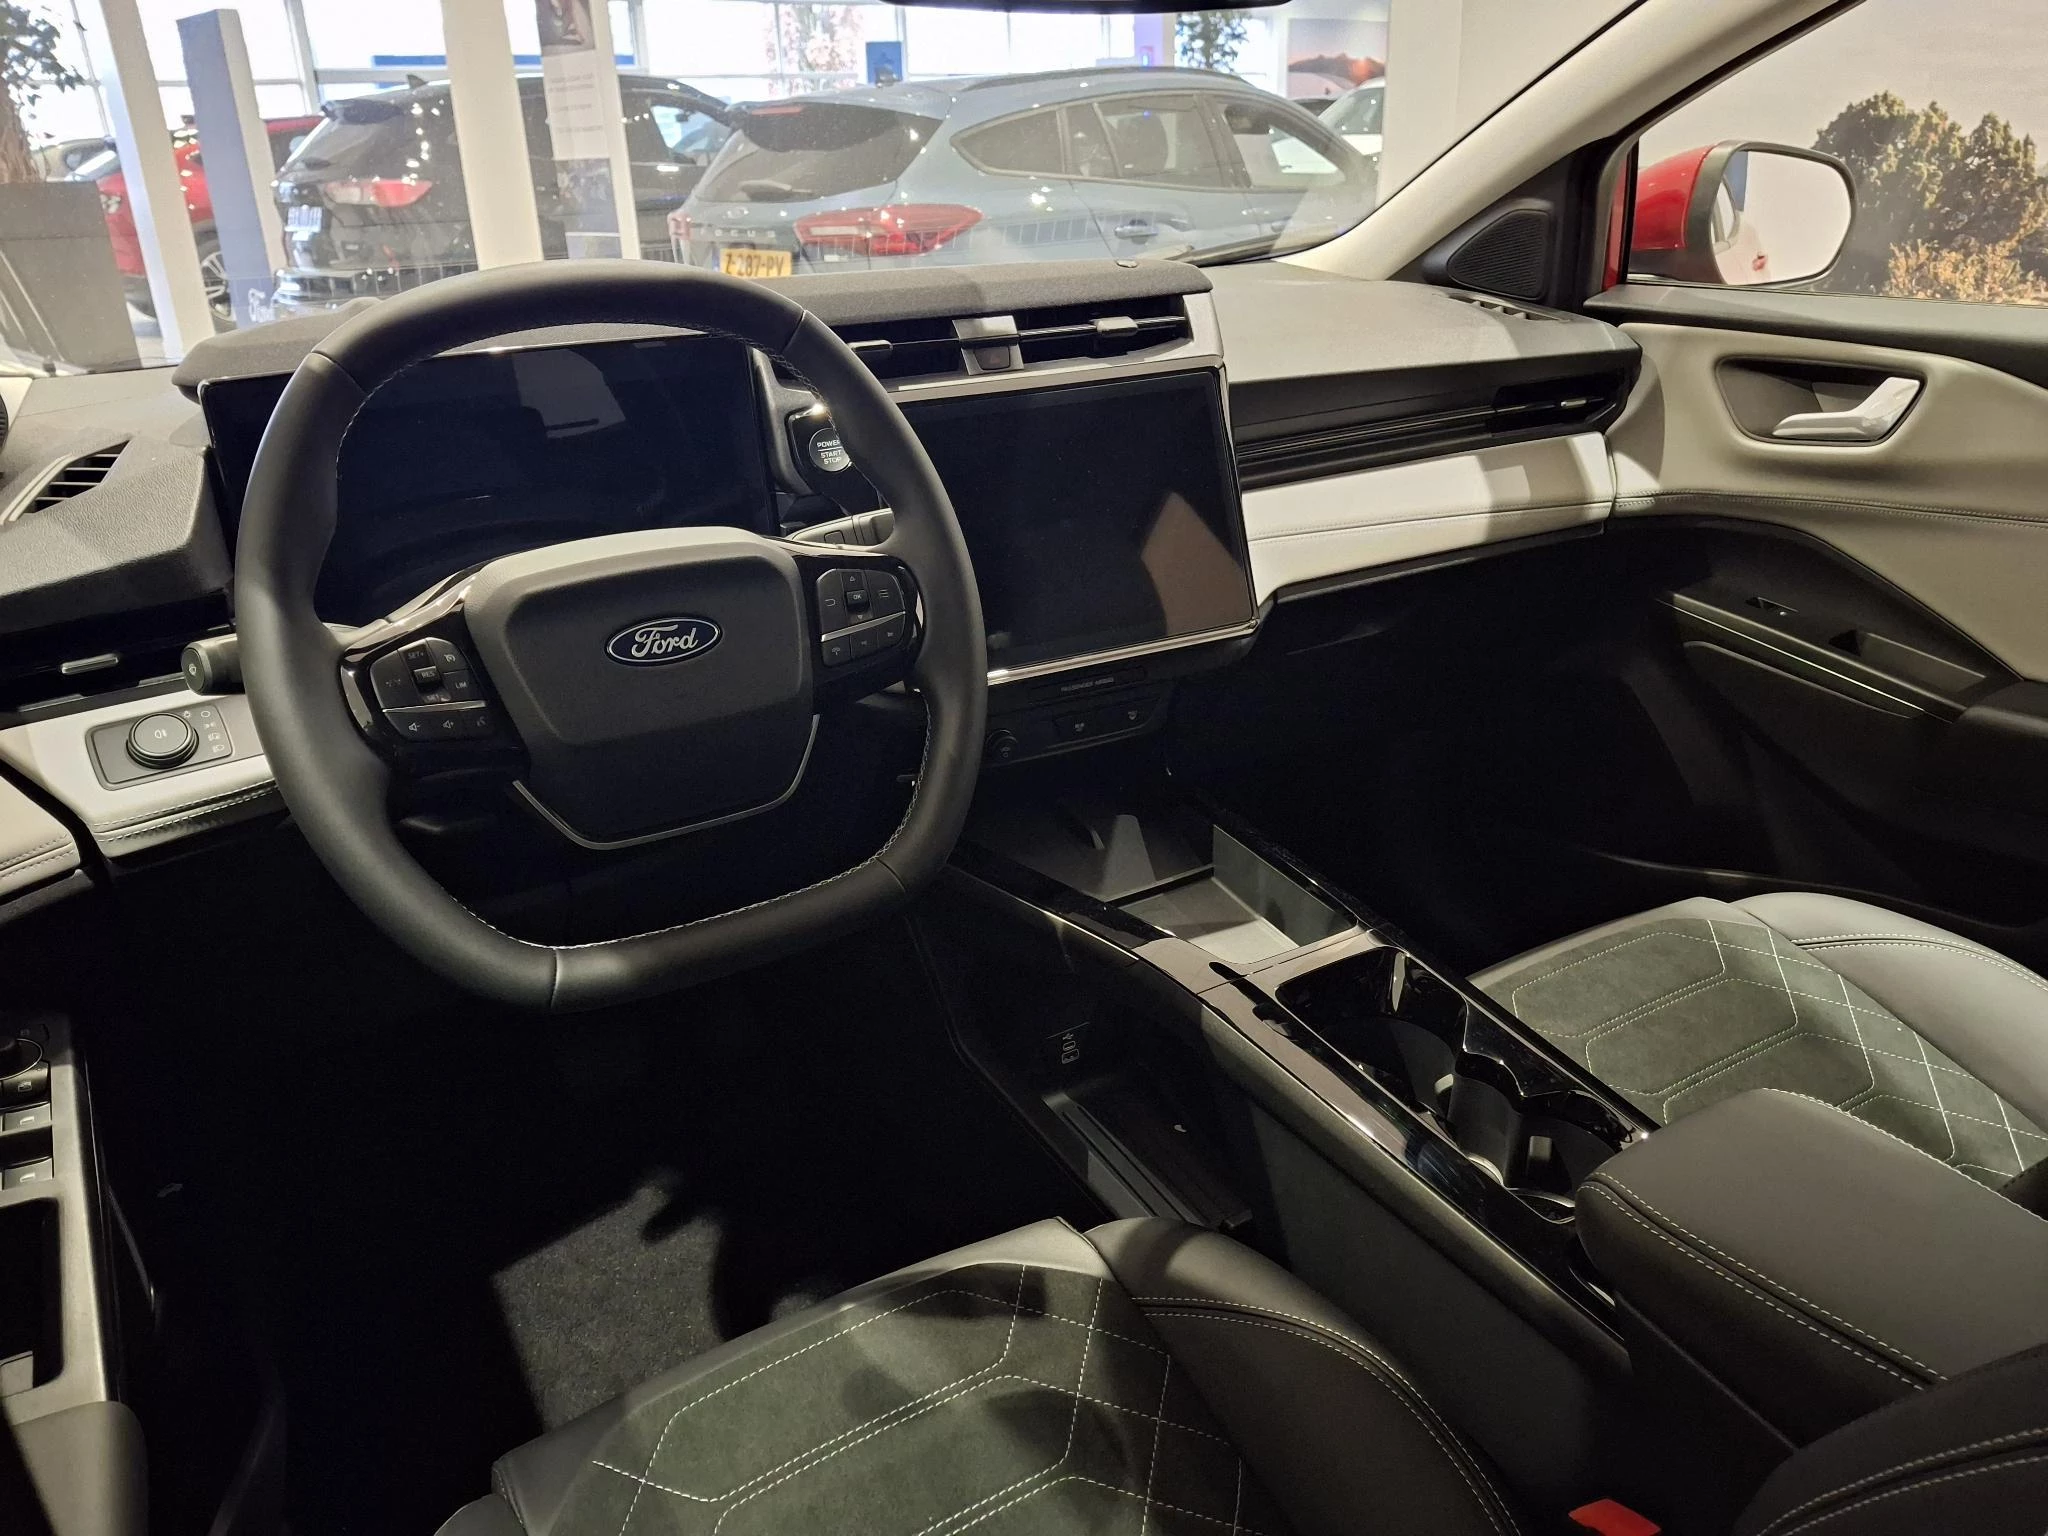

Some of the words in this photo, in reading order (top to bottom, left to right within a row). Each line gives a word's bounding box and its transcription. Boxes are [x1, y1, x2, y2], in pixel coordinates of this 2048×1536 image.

[821, 449, 842, 459] START
[823, 457, 842, 465] STOP
[631, 624, 699, 658] Ford
